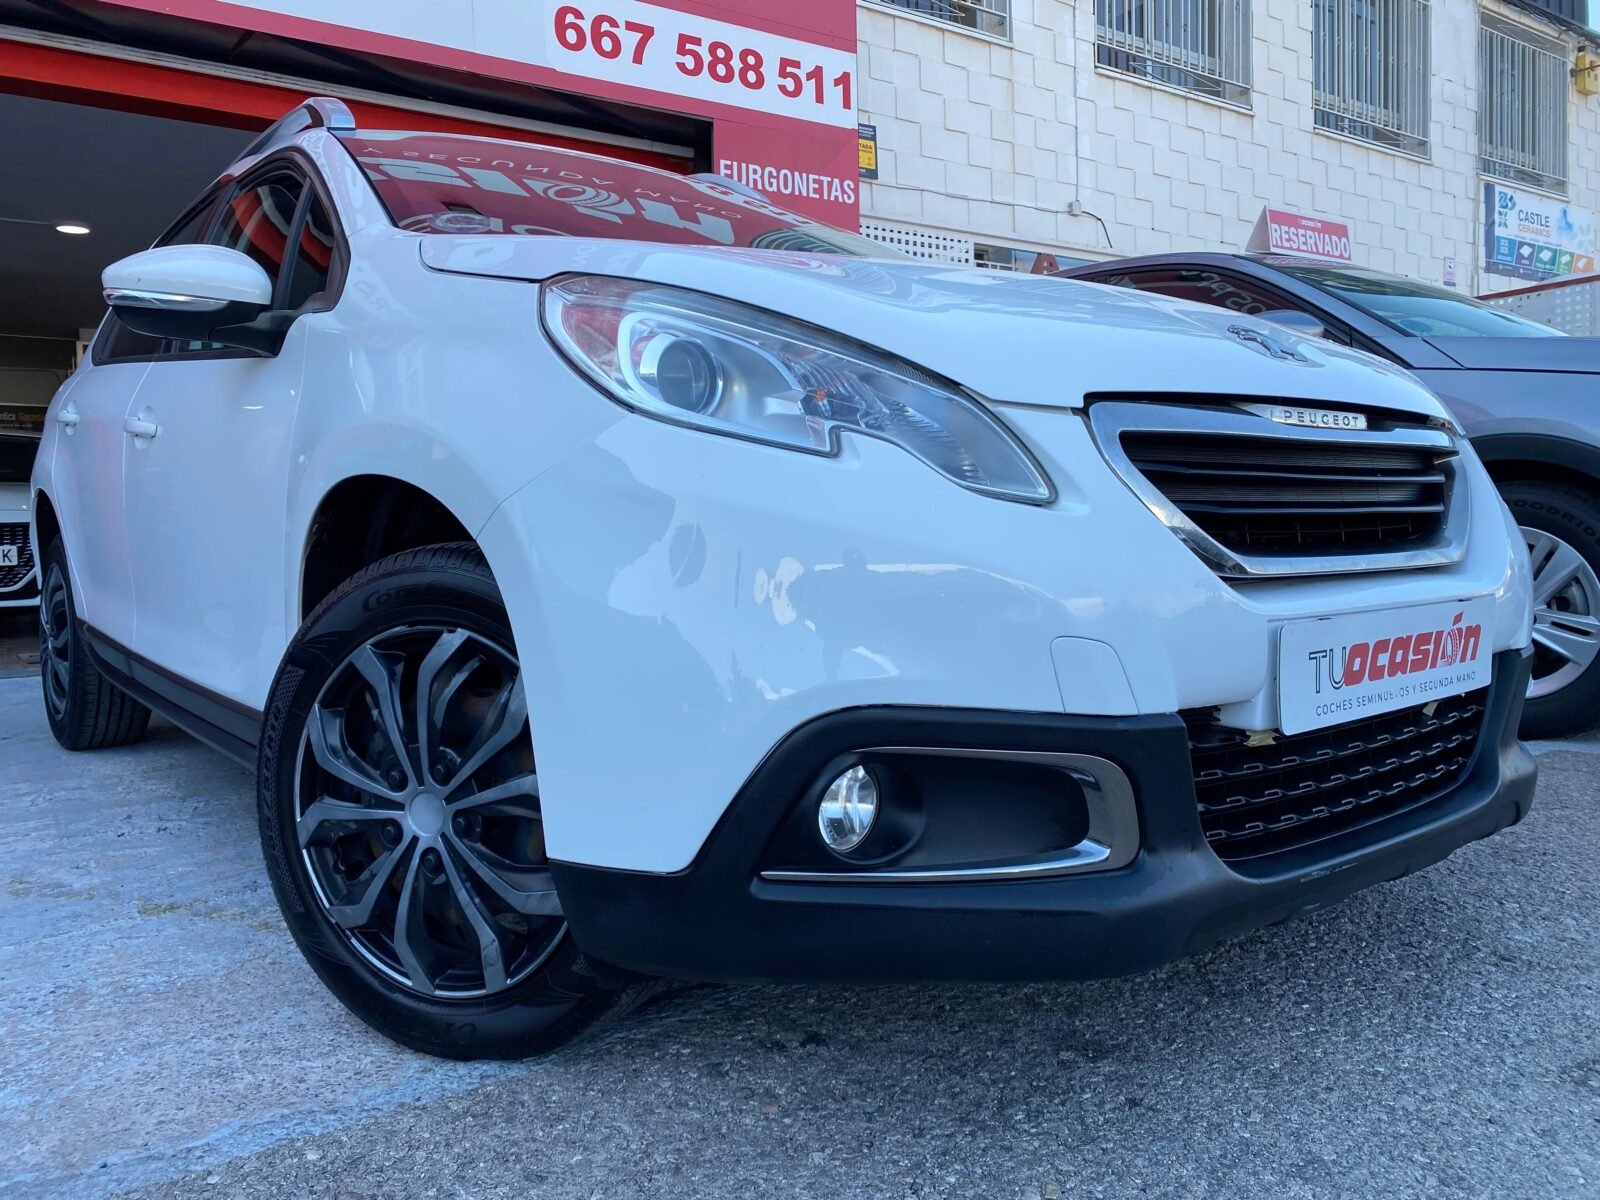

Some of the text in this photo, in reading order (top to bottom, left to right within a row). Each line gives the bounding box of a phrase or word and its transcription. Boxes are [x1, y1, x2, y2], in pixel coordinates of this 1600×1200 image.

[554, 5, 852, 110] 667 588 511
[720, 159, 855, 204] FURGONETAS
[1518, 209, 1550, 228] CASTLE
[1518, 223, 1551, 238] CERAMICS
[1271, 223, 1350, 258] RESERVADO
[1284, 409, 1359, 427] PEUGEOT
[1316, 671, 1476, 716] COCHES SEMINUEOS Y SEGUNDA MANO
